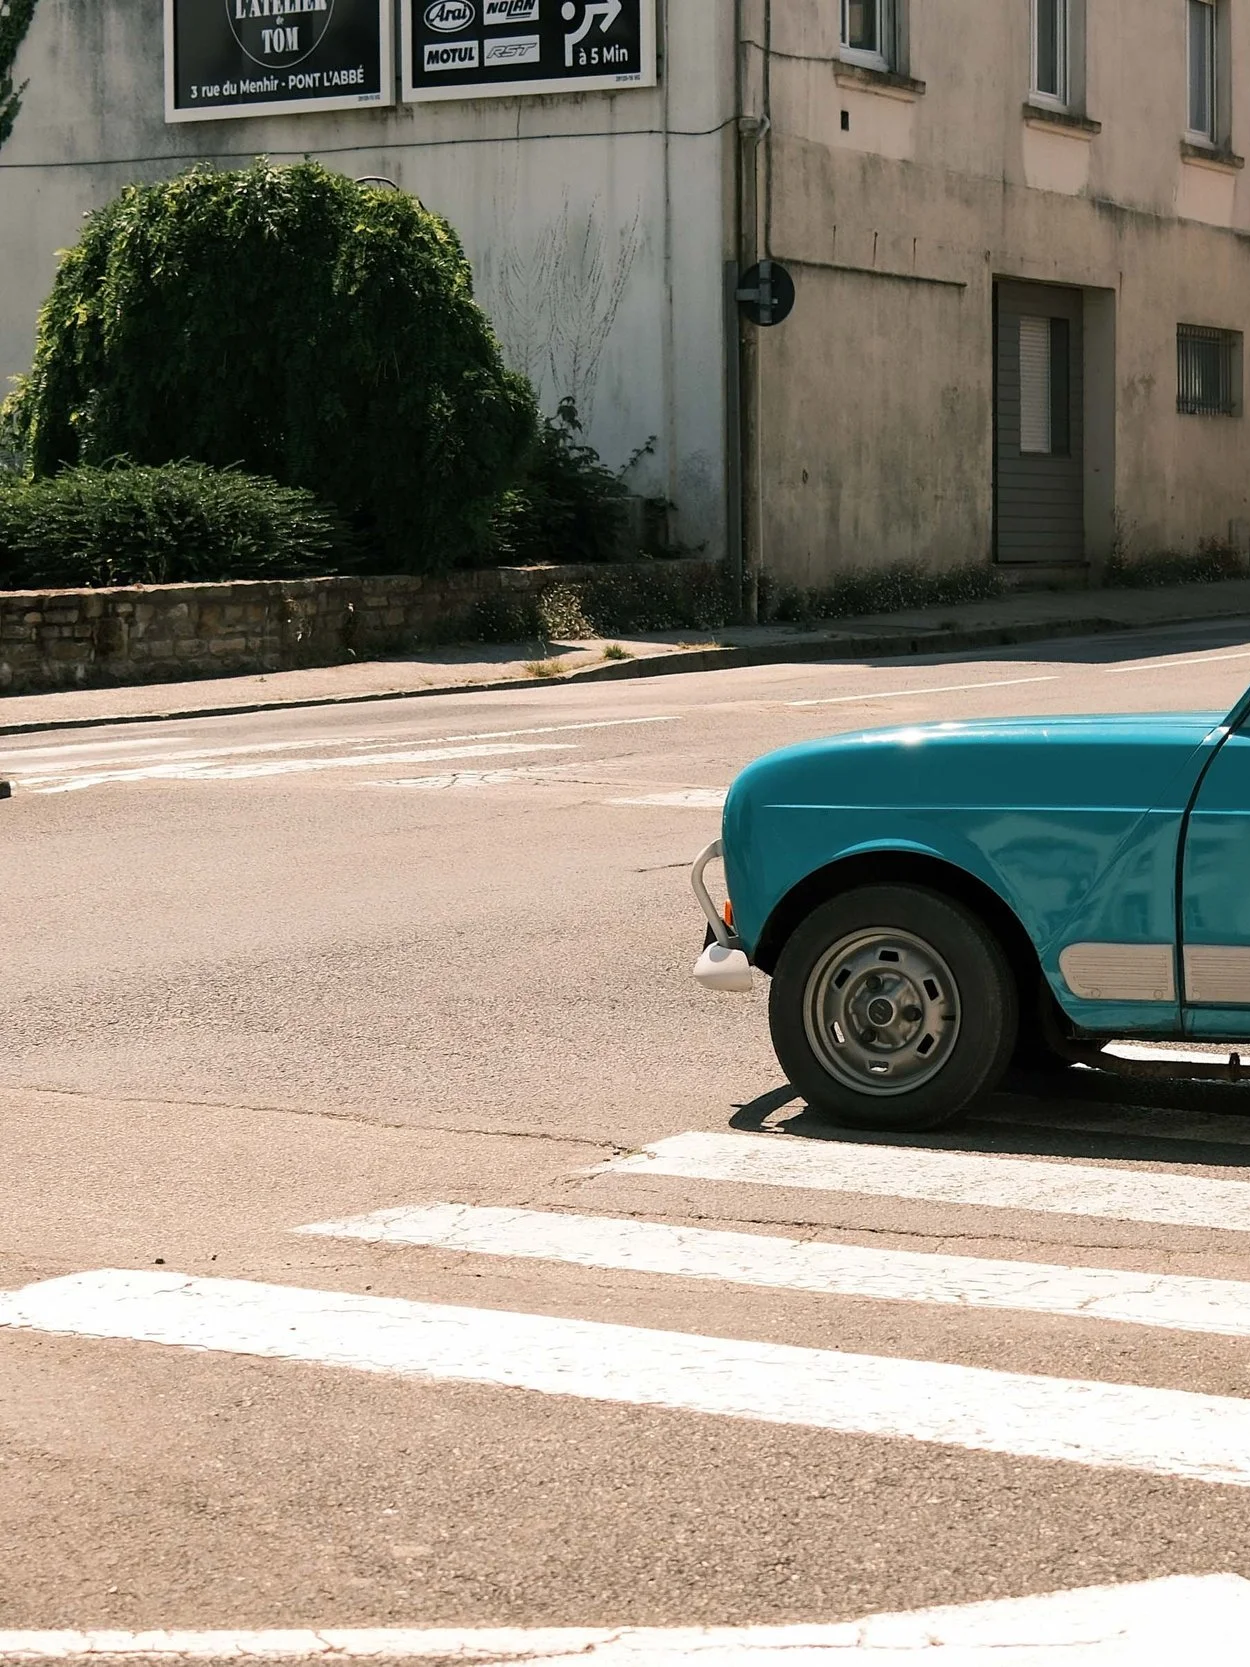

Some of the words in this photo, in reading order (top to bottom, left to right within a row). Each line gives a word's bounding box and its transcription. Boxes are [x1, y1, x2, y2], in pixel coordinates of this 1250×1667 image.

[432, 4, 467, 22] Arai
[487, 0, 536, 16] NOLAN
[262, 27, 299, 54] TOM
[427, 47, 474, 64] MOTUL
[486, 42, 537, 59] RST
[579, 48, 586, 65] à
[591, 48, 598, 64] 5
[603, 44, 628, 64] Min
[190, 86, 198, 98] 3
[202, 84, 220, 97] rue
[223, 81, 236, 96] du
[240, 75, 278, 94] Menhir
[288, 72, 320, 90] PONT
[324, 65, 364, 87] L'ABBÉ
